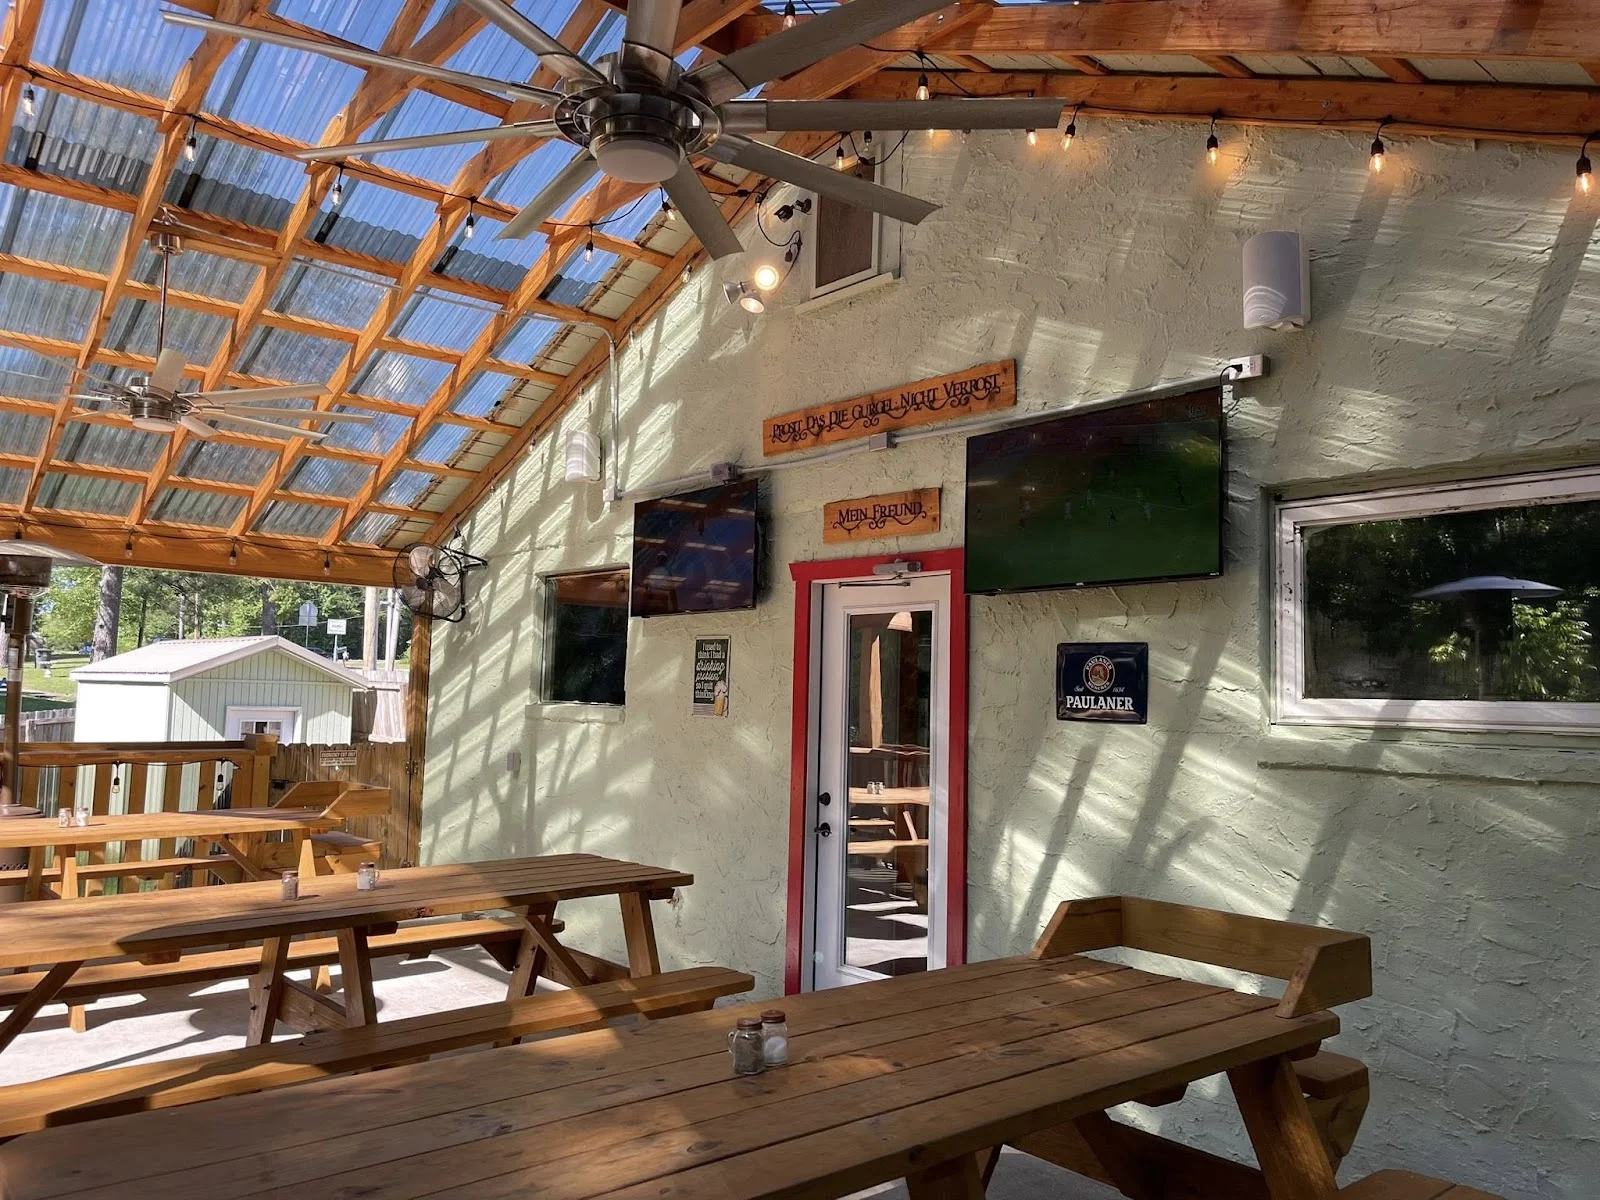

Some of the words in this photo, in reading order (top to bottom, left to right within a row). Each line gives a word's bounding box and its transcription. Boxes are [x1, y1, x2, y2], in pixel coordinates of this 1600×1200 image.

[806, 415, 826, 428] DAS
[829, 409, 848, 425] DIE
[900, 388, 939, 406] NICHT
[943, 374, 1000, 397] VERROST
[838, 508, 868, 524] MEIN
[872, 502, 923, 519] FREUND
[1086, 657, 1112, 670] PAULANER
[1066, 696, 1134, 710] PAULANER
